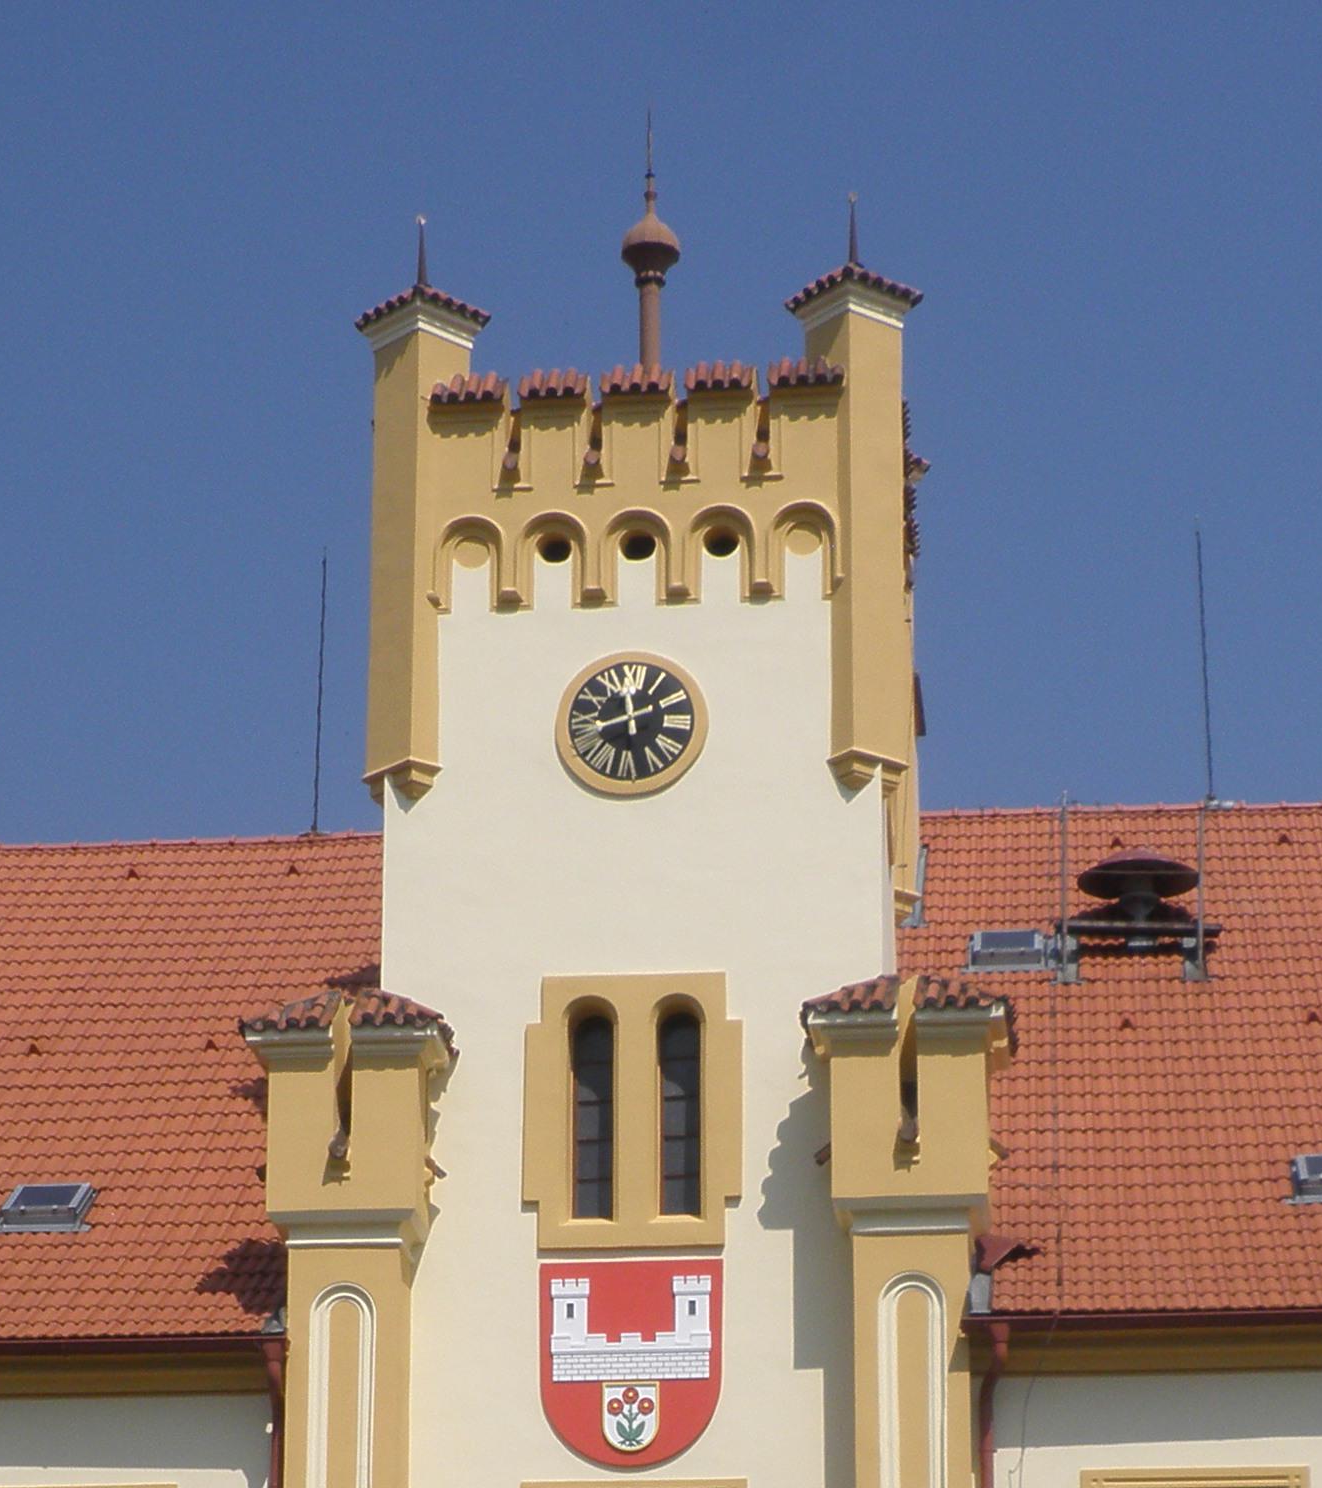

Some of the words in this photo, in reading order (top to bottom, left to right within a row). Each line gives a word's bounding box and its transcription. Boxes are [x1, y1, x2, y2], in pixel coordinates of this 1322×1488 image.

[595, 668, 622, 697] XI
[648, 671, 666, 695] I
[578, 687, 608, 710] X
[659, 689, 687, 709] II
[662, 714, 691, 730] III
[590, 742, 616, 774] VII
[617, 750, 637, 779] VI
[645, 746, 664, 773] V
